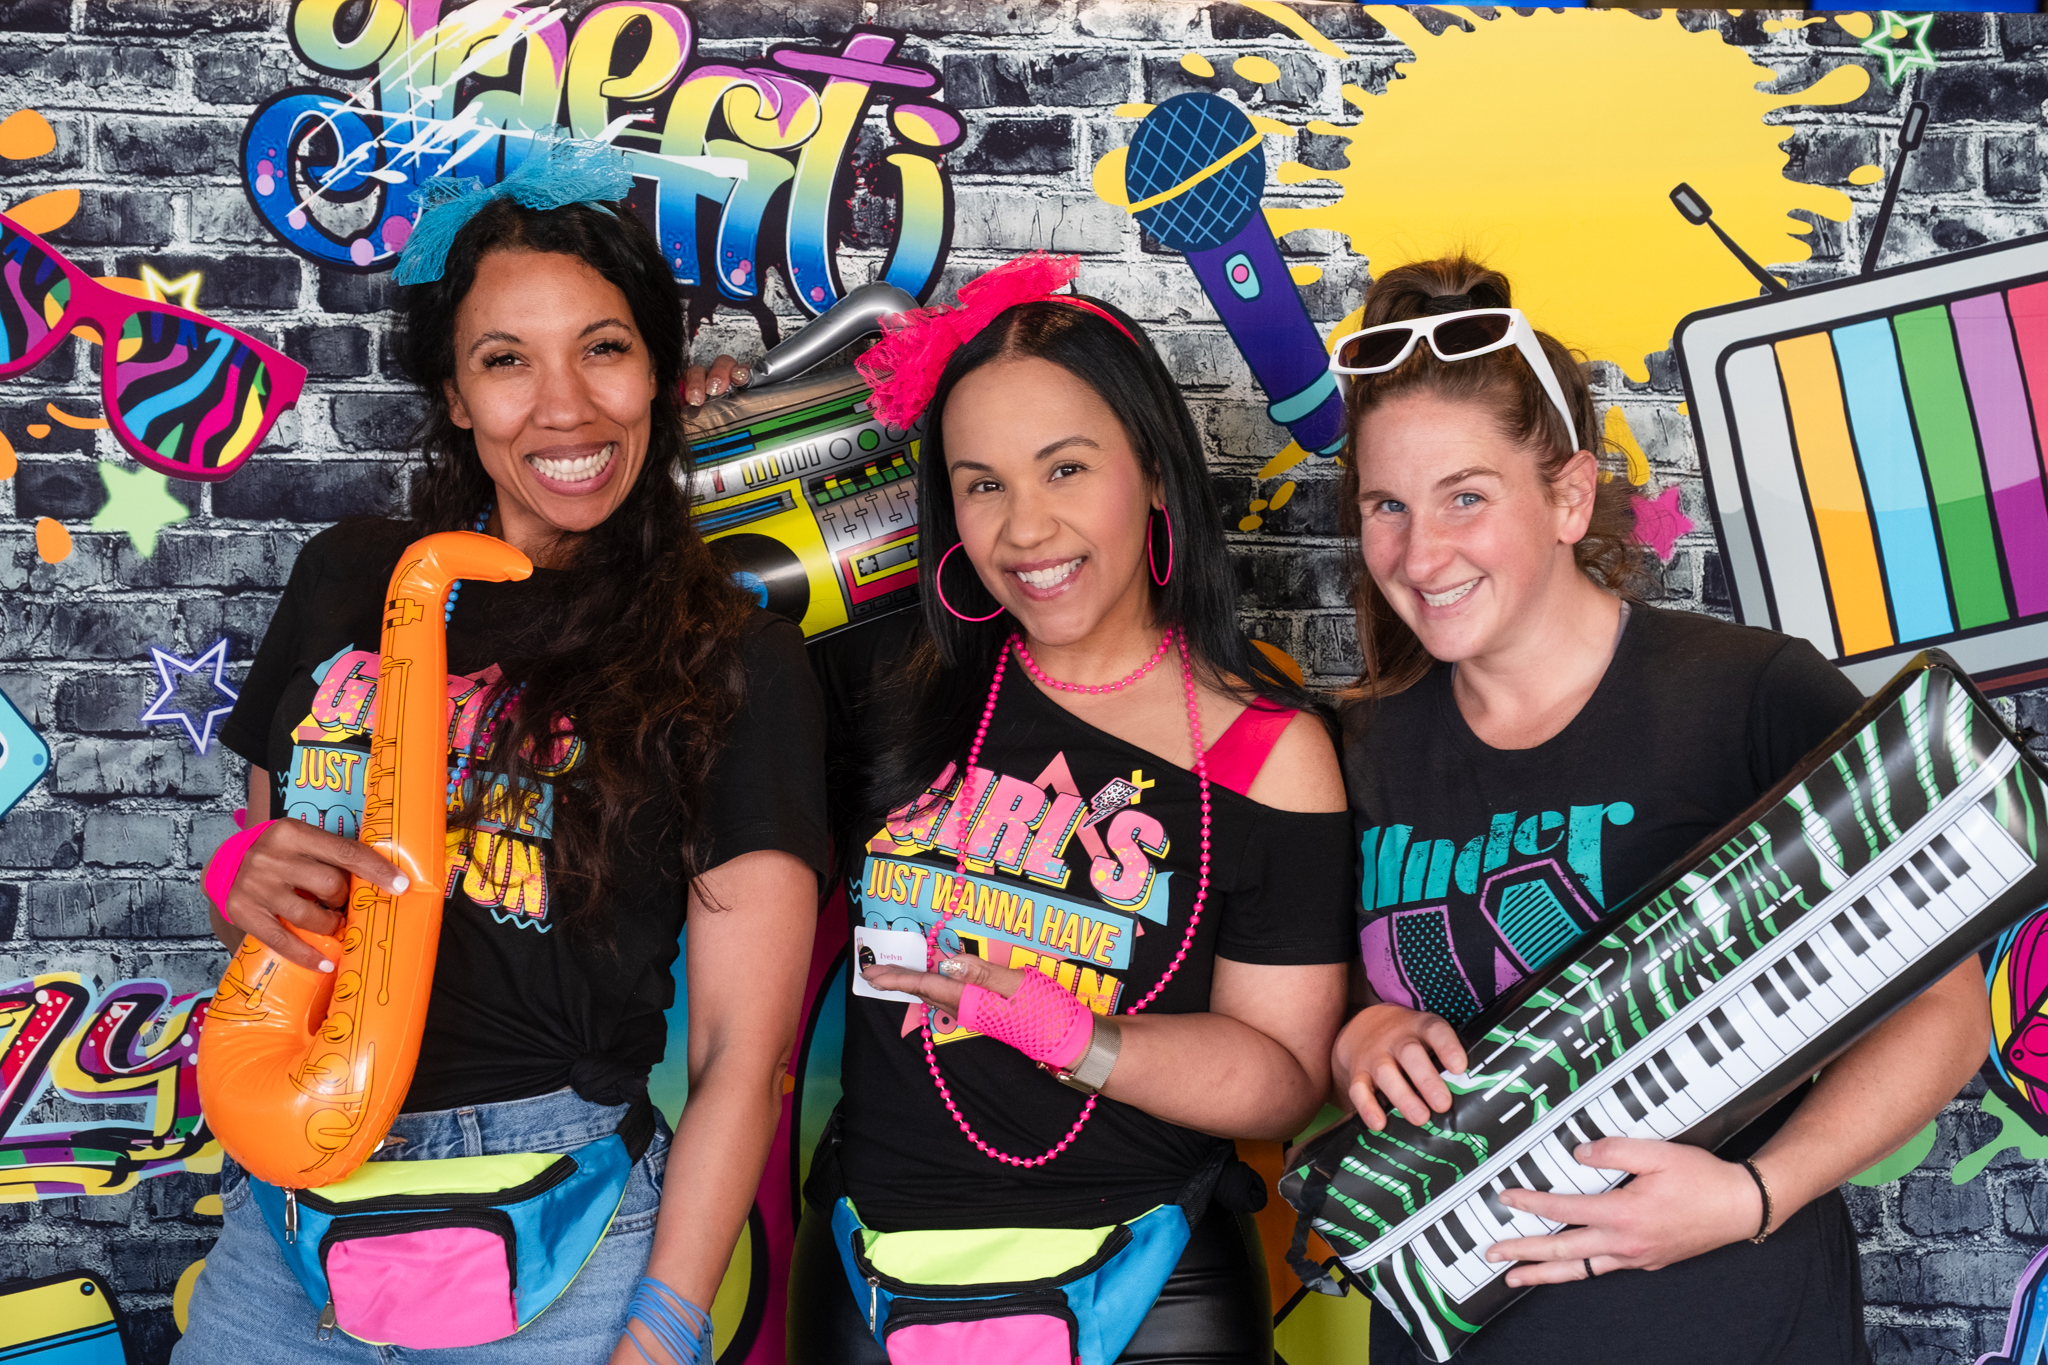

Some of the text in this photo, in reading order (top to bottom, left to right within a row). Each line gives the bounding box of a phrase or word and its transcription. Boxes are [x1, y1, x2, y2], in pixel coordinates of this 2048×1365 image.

[295, 747, 360, 795] JUST
[1360, 800, 1635, 910] Under
[866, 859, 1122, 967] JUST WANNA HAVE
